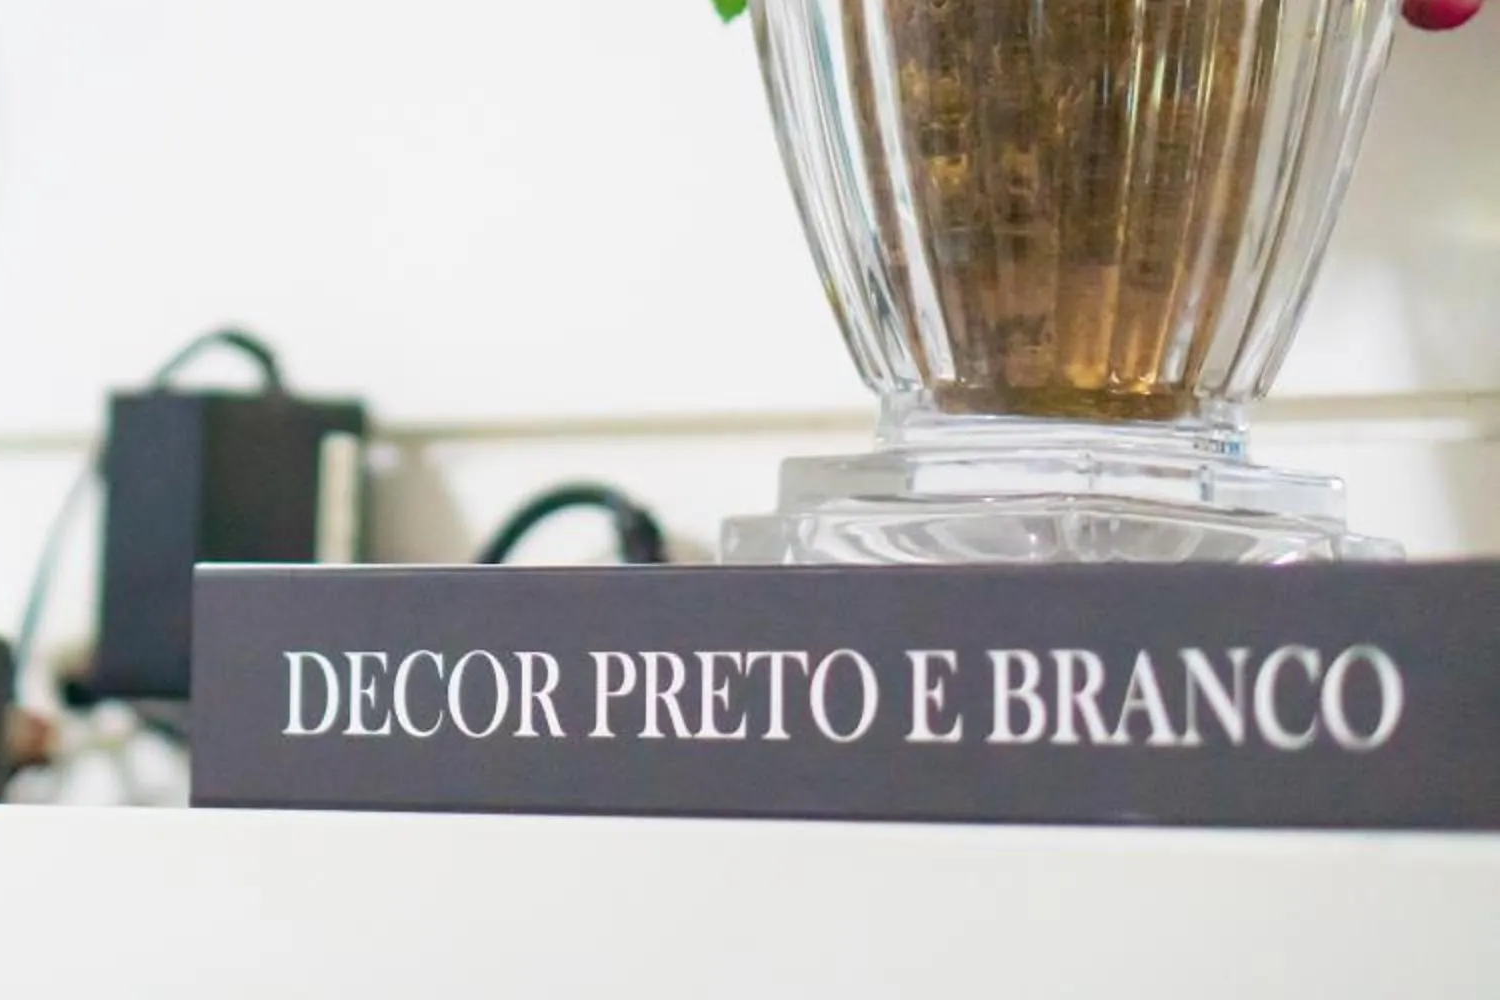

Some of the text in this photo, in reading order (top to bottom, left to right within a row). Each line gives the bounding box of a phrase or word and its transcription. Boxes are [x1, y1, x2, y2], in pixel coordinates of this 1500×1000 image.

[282, 646, 1404, 748] DECOR PRETO E BRANCO
